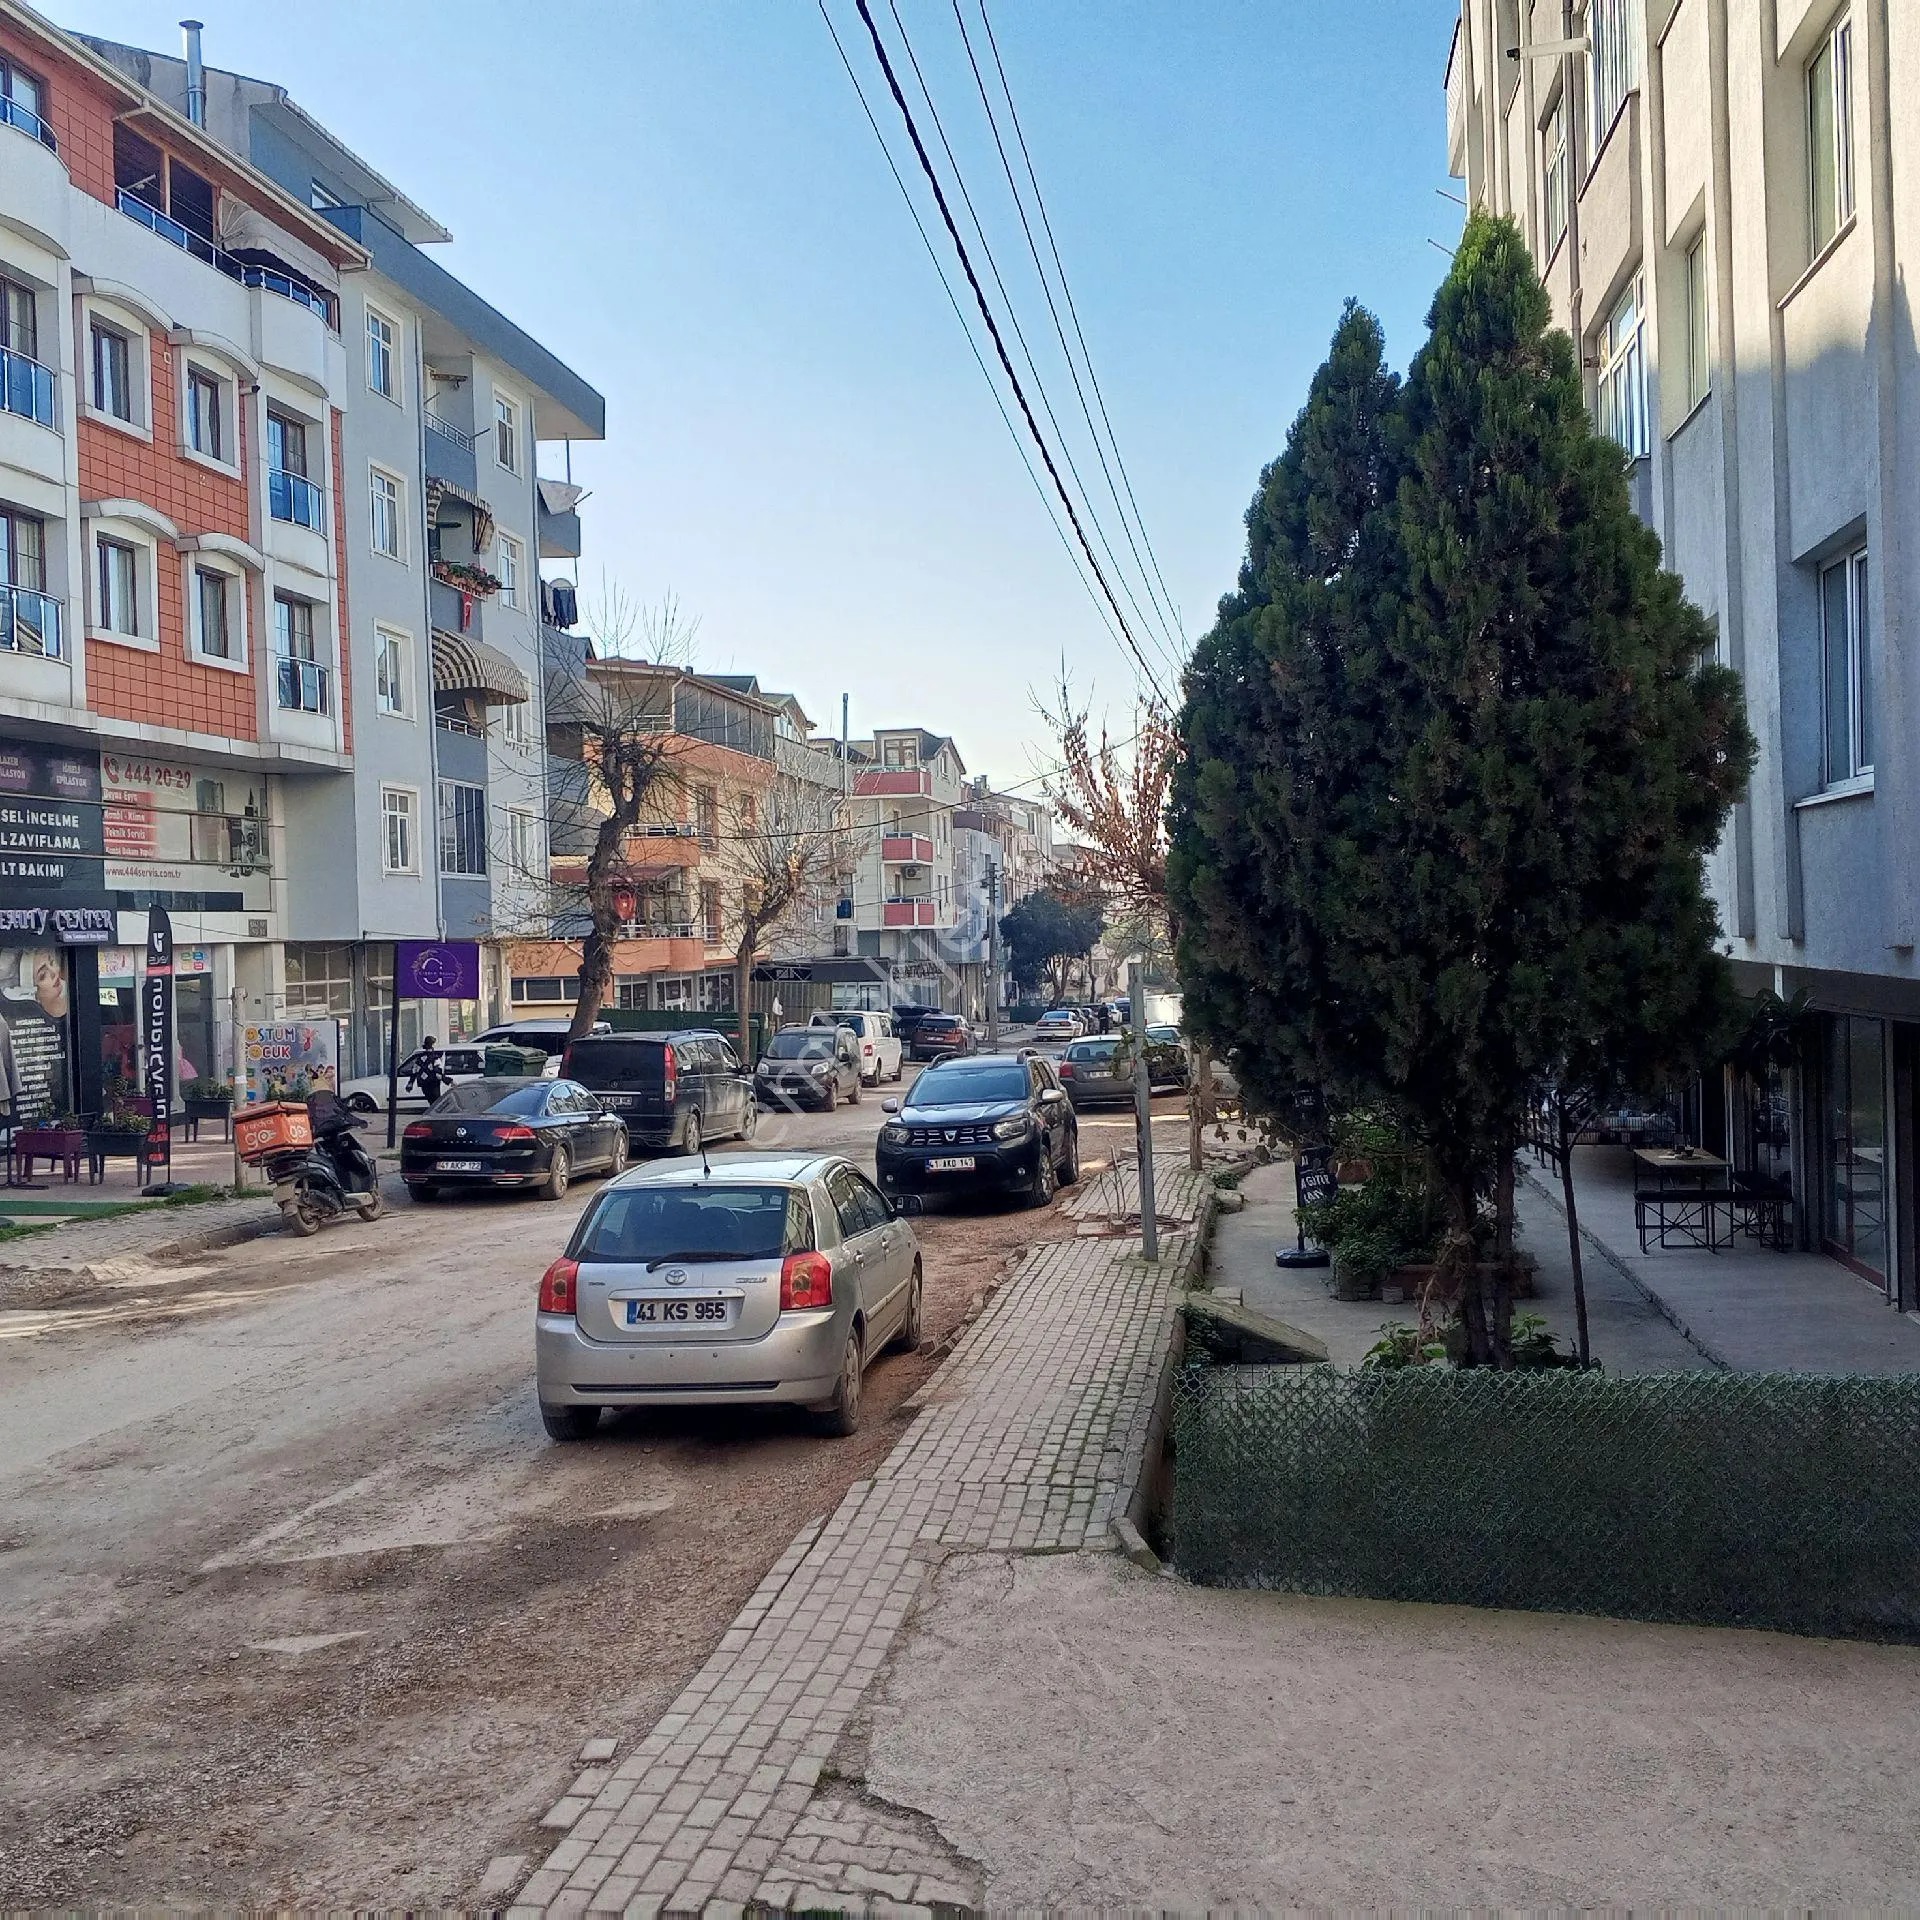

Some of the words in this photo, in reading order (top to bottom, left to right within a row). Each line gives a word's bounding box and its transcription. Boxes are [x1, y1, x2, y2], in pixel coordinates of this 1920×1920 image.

[124, 762, 151, 785] 444
[1, 808, 24, 824] SEL
[26, 809, 79, 828] İNCELME
[9, 832, 81, 850] ZAYIFLAMA
[106, 827, 126, 838] Teknik
[128, 828, 146, 840] Servis
[18, 862, 64, 878] BAKIMI
[245, 1025, 296, 1042] OSTÜM
[636, 1303, 656, 1321] 41
[663, 1303, 689, 1321] KS
[694, 1302, 726, 1320] 955
